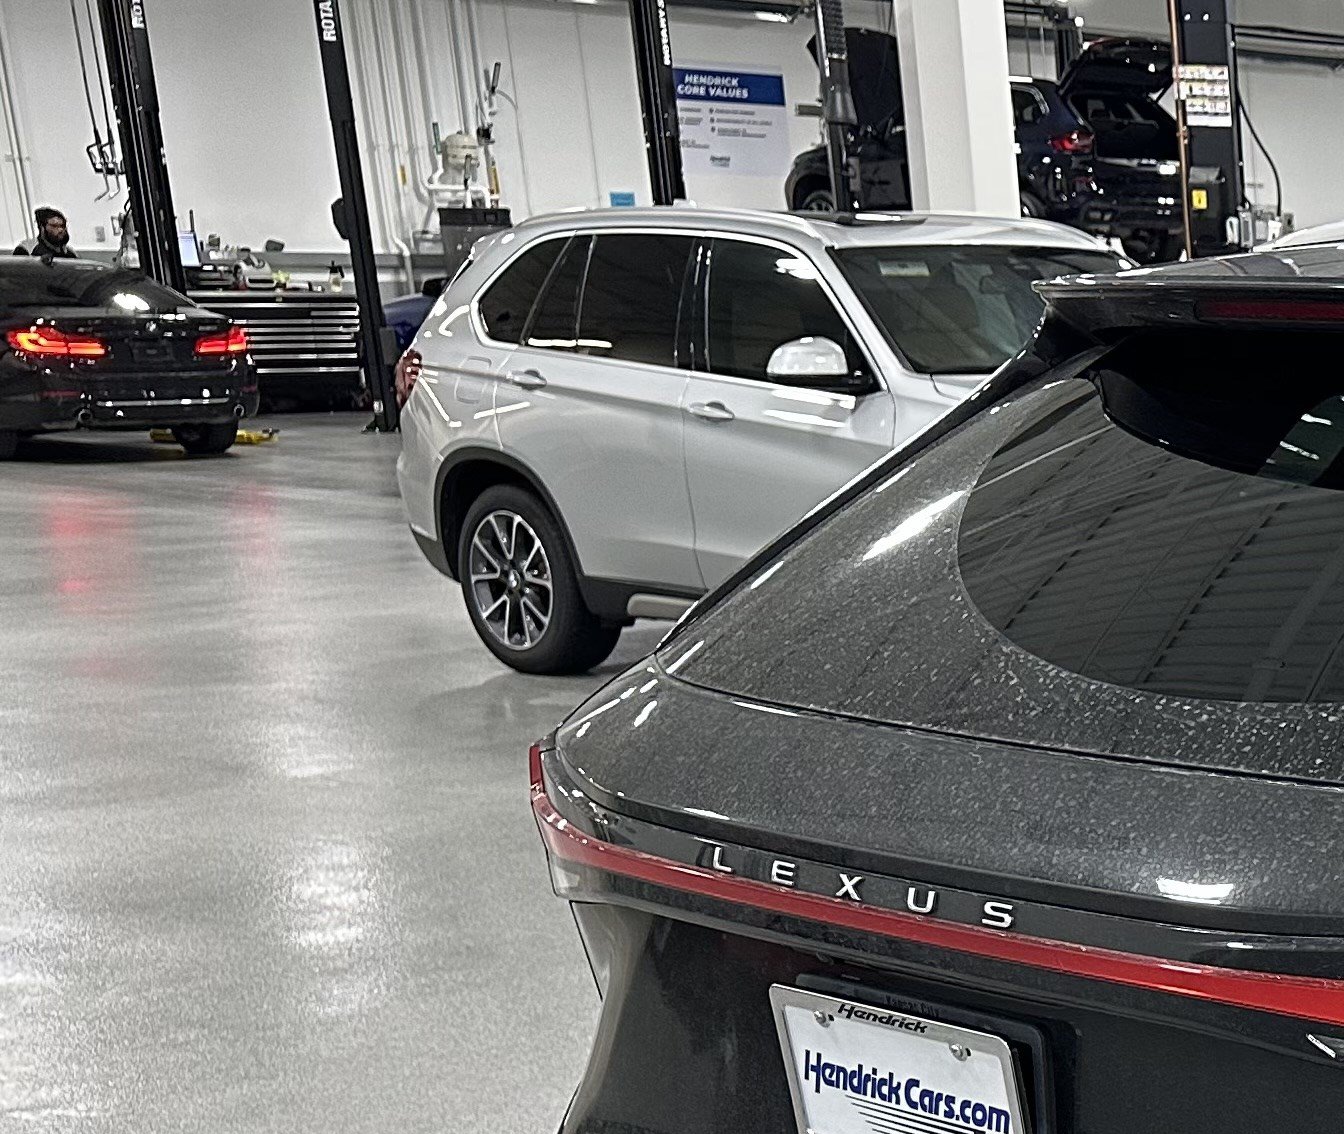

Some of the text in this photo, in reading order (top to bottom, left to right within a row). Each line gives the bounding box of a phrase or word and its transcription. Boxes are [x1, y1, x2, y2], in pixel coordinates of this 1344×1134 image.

[677, 84, 749, 99] CORE VALUES
[684, 74, 740, 87] HENDRICK
[712, 846, 1014, 929] LEXUS
[837, 1003, 928, 1034] Hendrick
